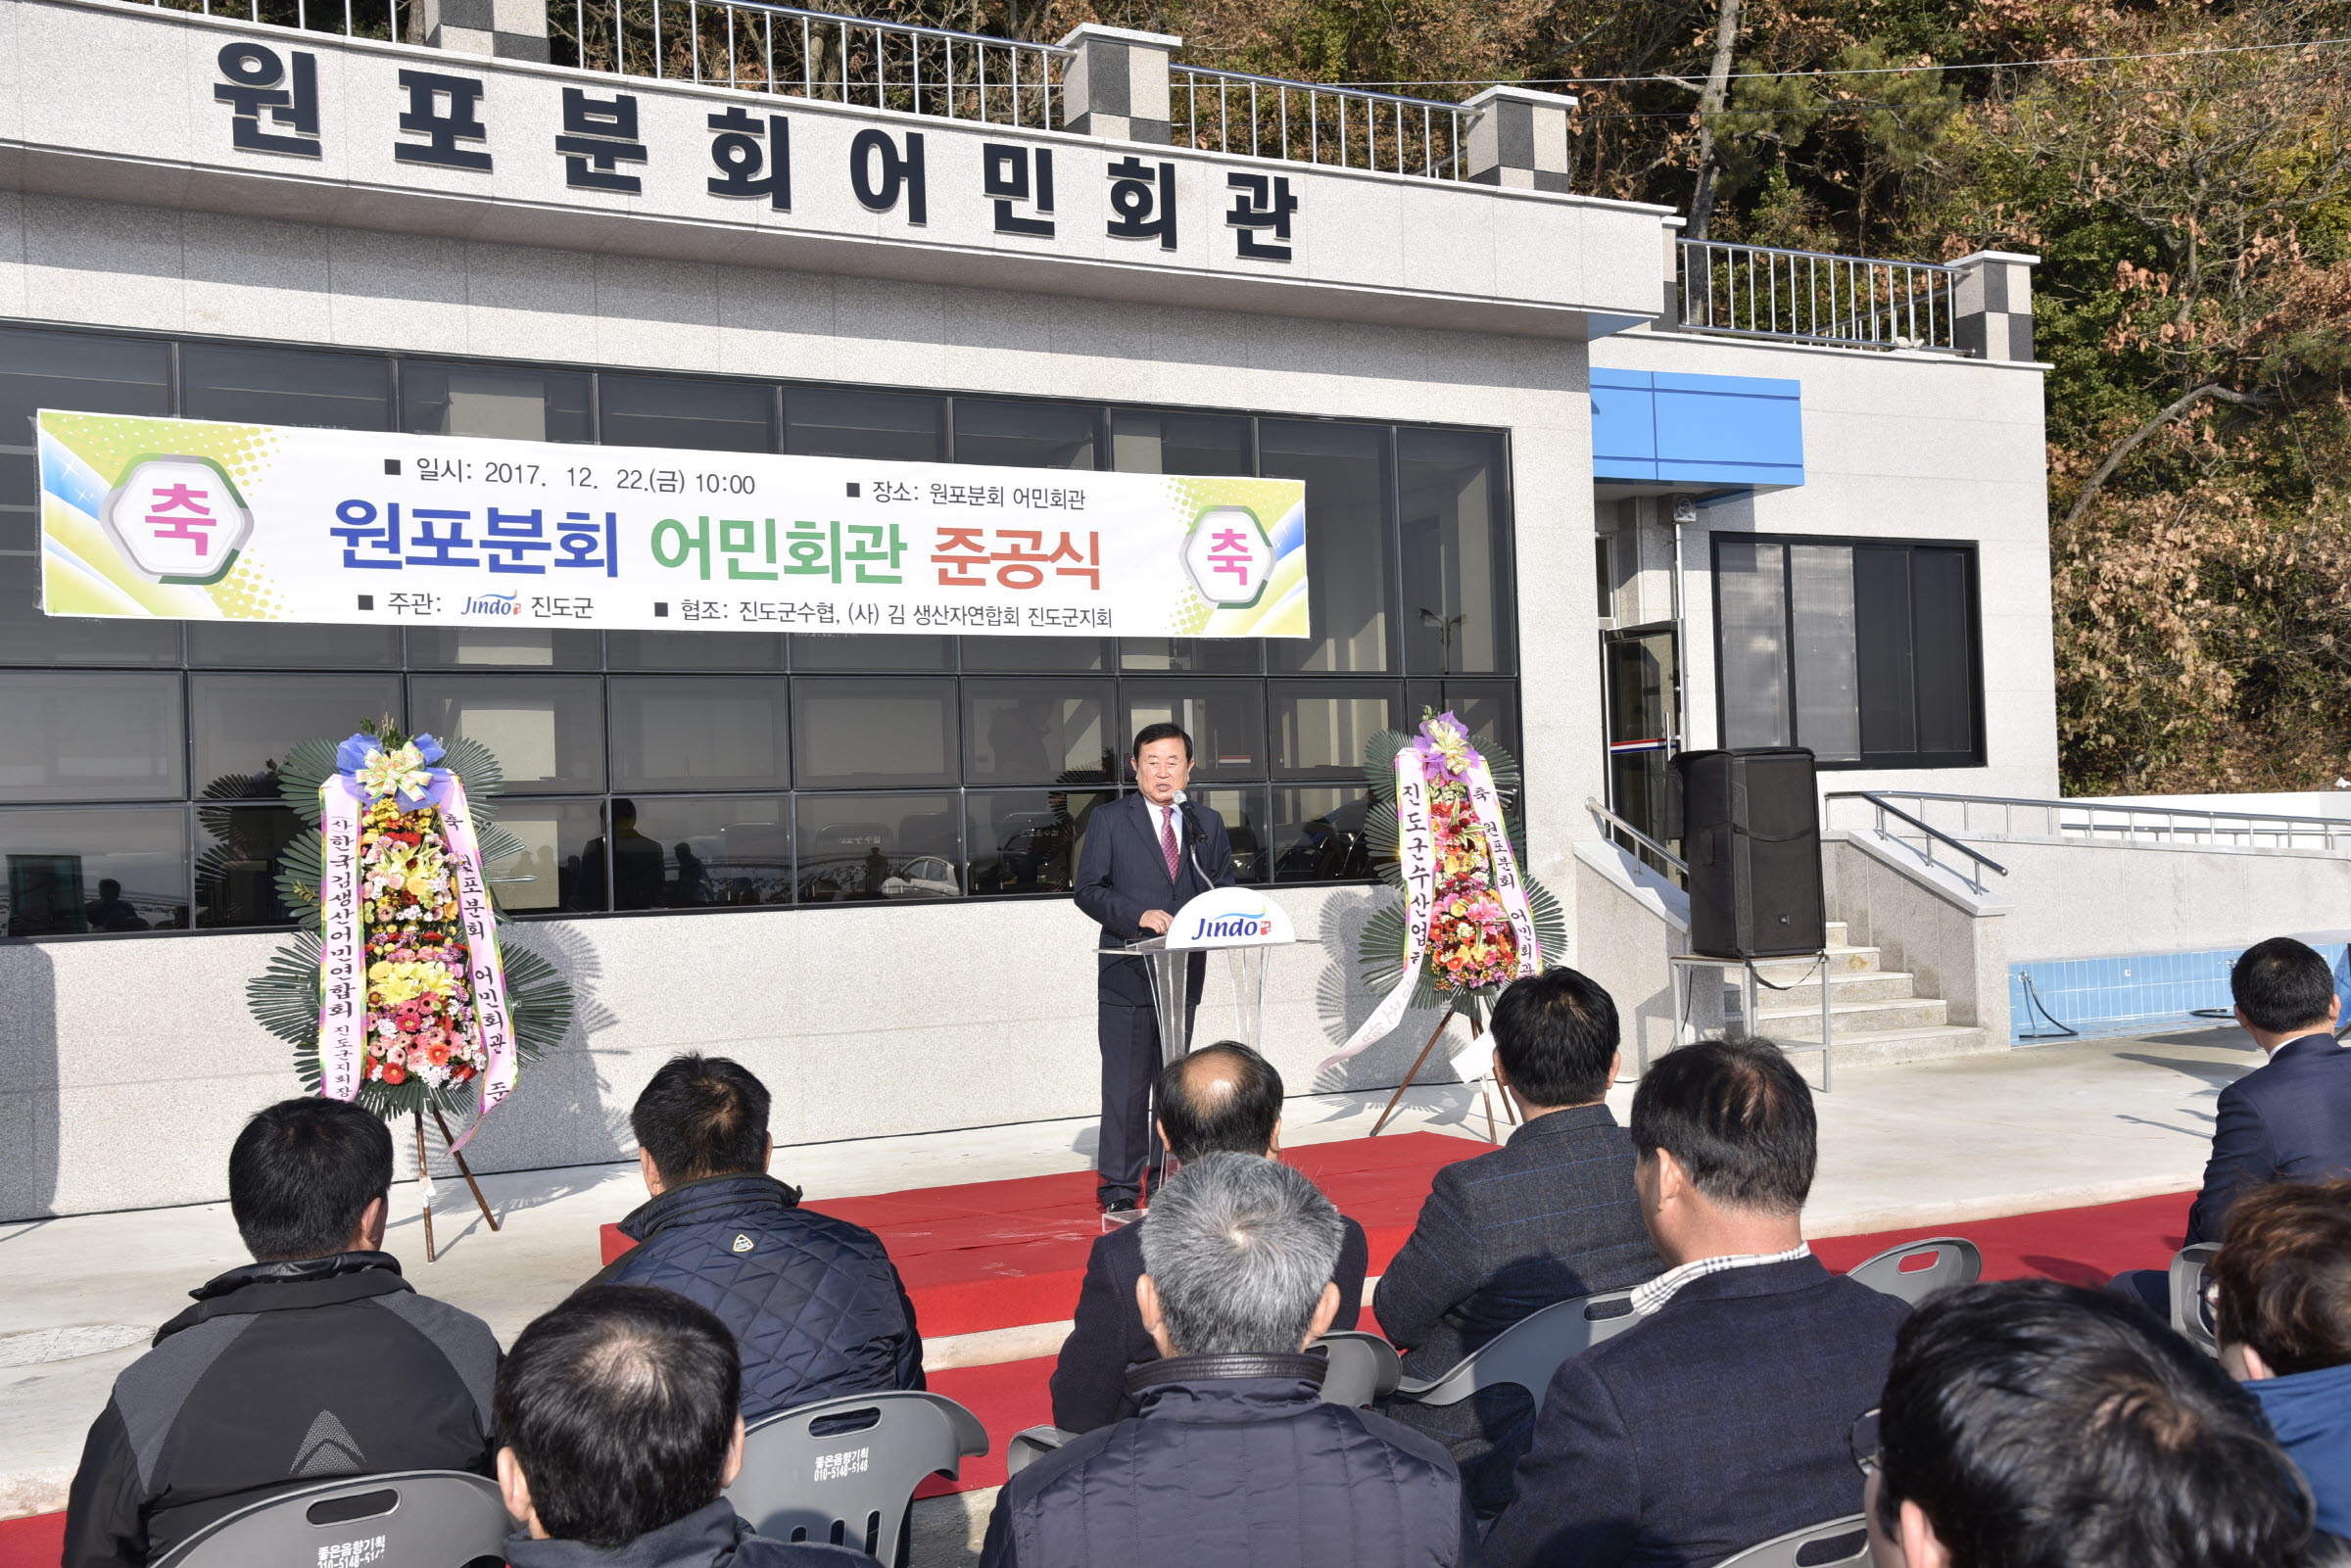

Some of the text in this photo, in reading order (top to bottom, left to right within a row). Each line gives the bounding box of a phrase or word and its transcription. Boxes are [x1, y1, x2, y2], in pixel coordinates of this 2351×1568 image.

[416, 457, 755, 495] 일시: 2017. 12. 22.(금) 10:00
[873, 481, 1085, 510] 장소: 원포분회 어민회관
[144, 483, 217, 556] 축
[329, 499, 1101, 592] 원포분회 어민회관 준공식
[1207, 528, 1253, 586] 축
[388, 593, 441, 616] 주관:
[461, 594, 512, 616] Jindo
[531, 595, 594, 619] 진도군
[681, 599, 1112, 629] 협조: 진도군수협, (사) 김 생산자연합회 진도군지회
[1473, 787, 1490, 801] 축
[445, 813, 463, 831] 축
[475, 966, 505, 1054] 어민회관
[1190, 918, 1259, 941] Jindo
[814, 1458, 869, 1482] 010-5148-5148
[815, 1447, 869, 1469] 좋은음향기획
[317, 1534, 386, 1561] 좋은음향기획
[317, 1548, 385, 1568] 010-5148-51
